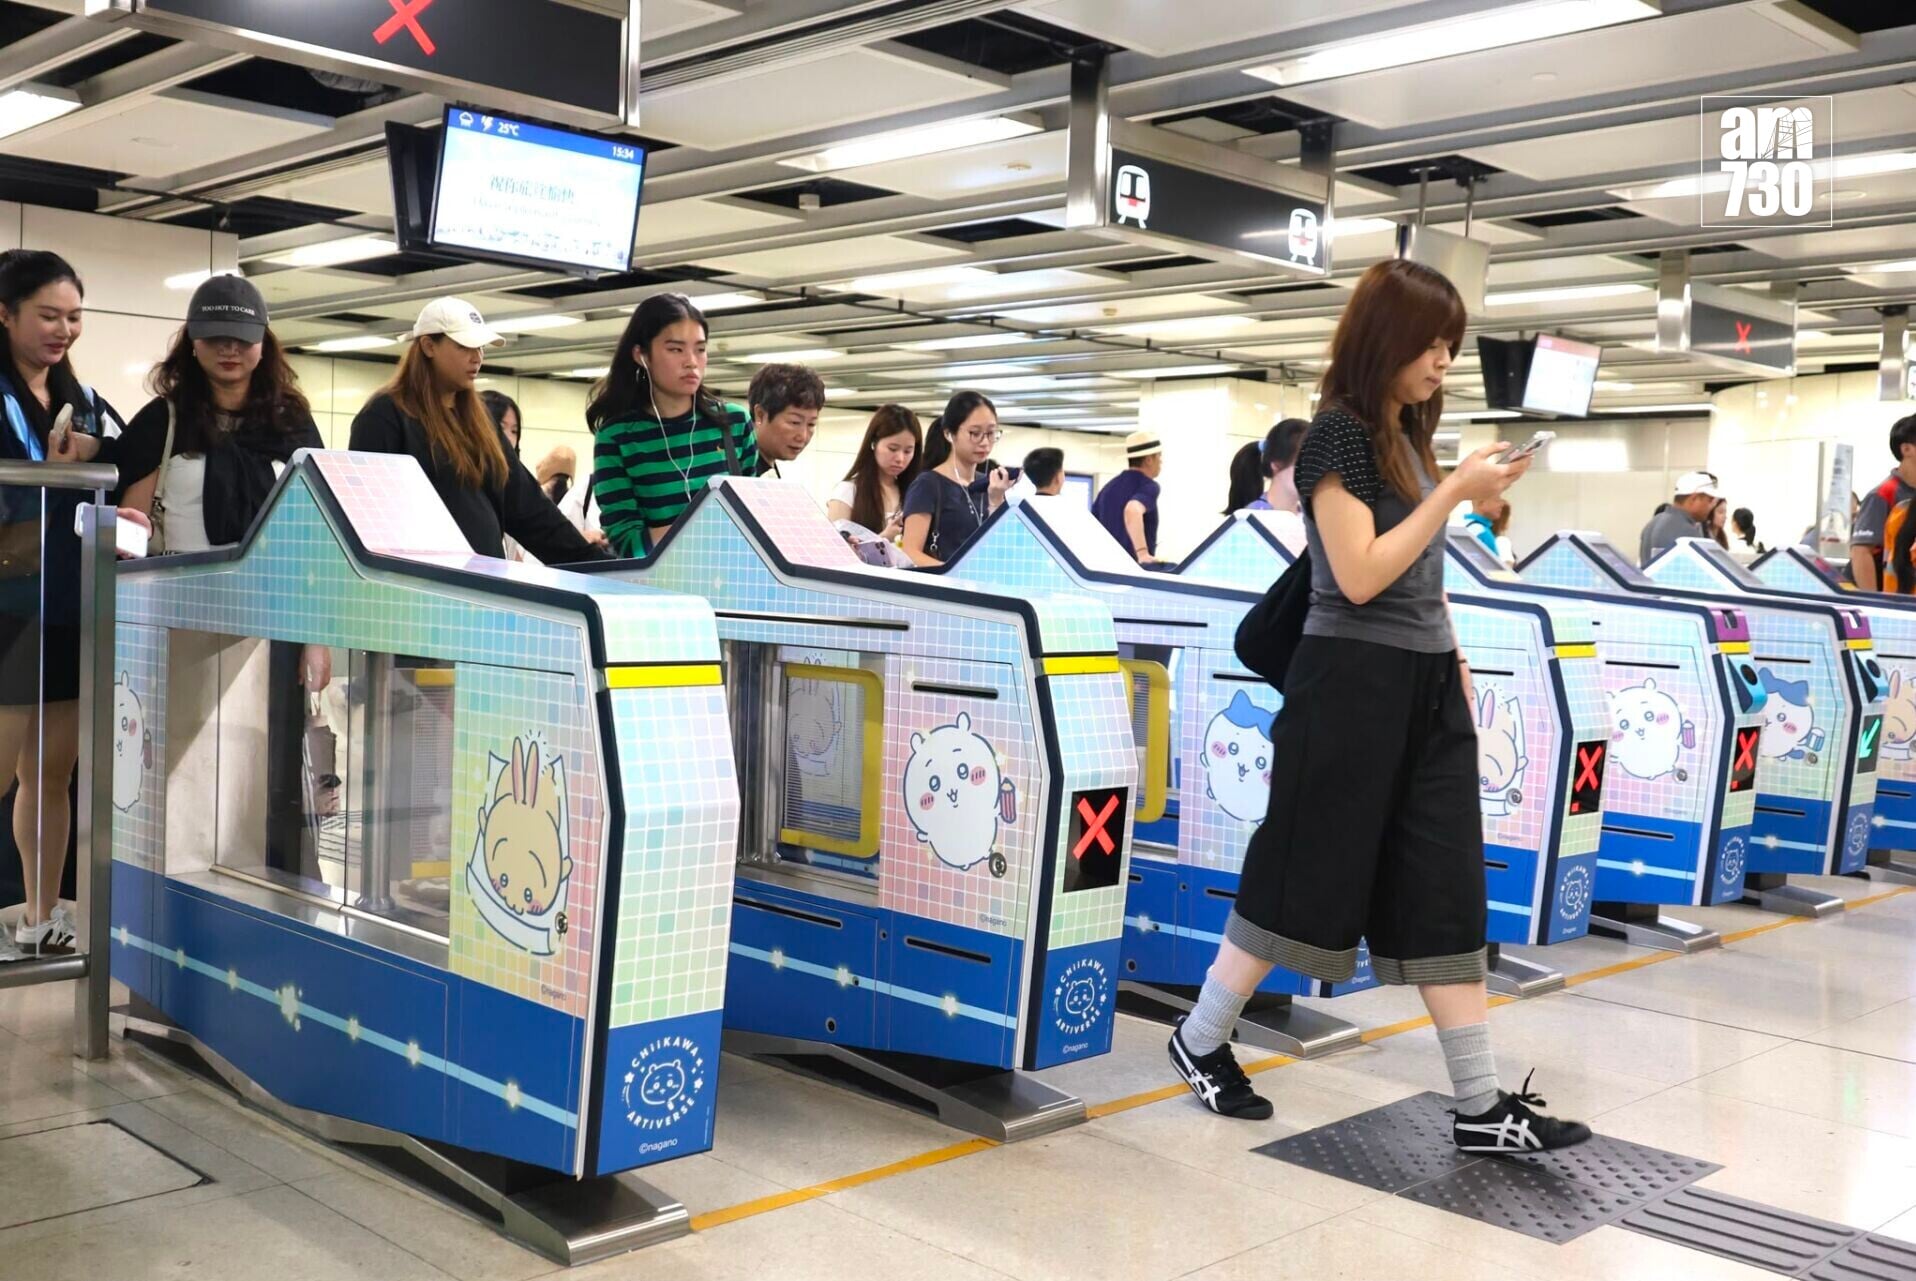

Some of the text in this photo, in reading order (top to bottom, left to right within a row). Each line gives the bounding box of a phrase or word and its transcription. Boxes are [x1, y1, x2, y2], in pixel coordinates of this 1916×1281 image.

[612, 146, 634, 160] 15:34
[1060, 958, 1105, 983] CHIIKAWA
[631, 1036, 699, 1068] CHIIKAWA
[626, 1098, 695, 1130] ARTIVERSE
